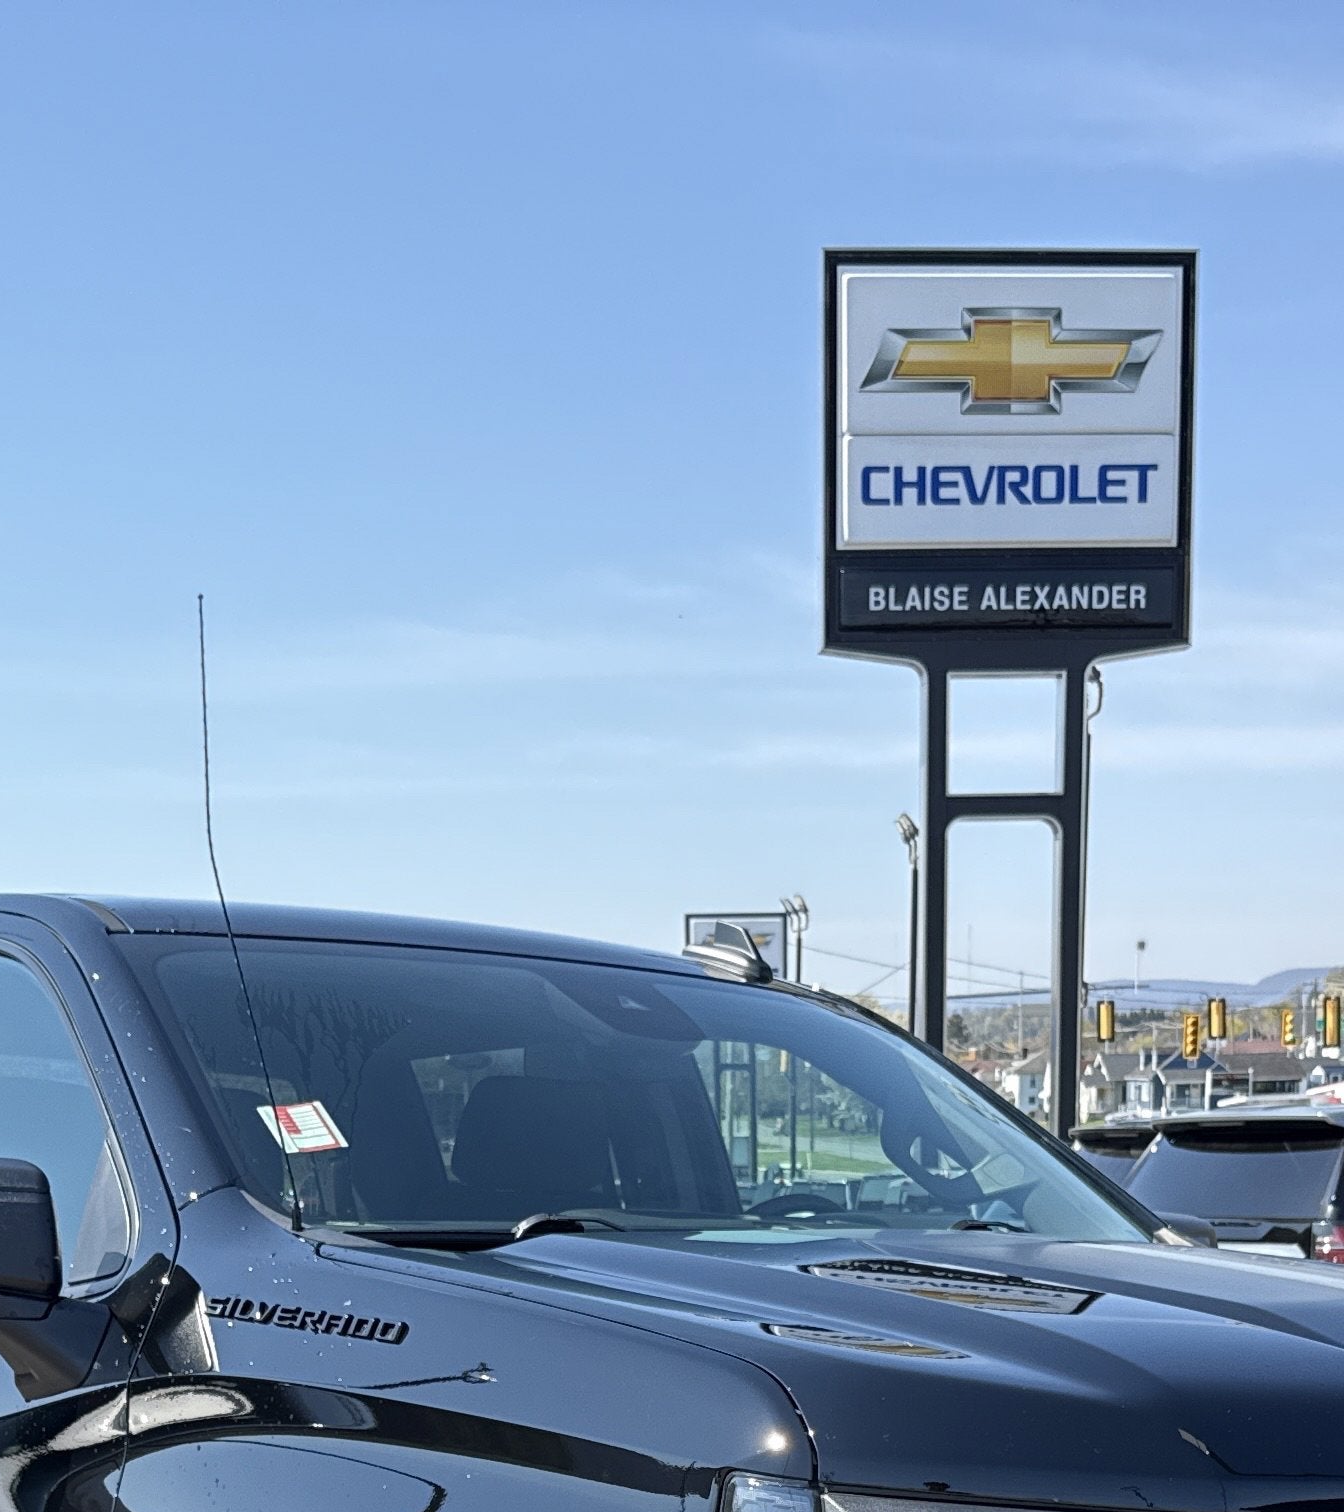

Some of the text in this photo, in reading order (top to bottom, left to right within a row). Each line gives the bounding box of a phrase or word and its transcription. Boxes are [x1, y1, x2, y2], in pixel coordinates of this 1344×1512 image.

[860, 464, 1158, 506] CHEVROLET
[868, 584, 1147, 612] BLAISE ALEXANDER
[205, 1296, 409, 1345] SILVERADO
